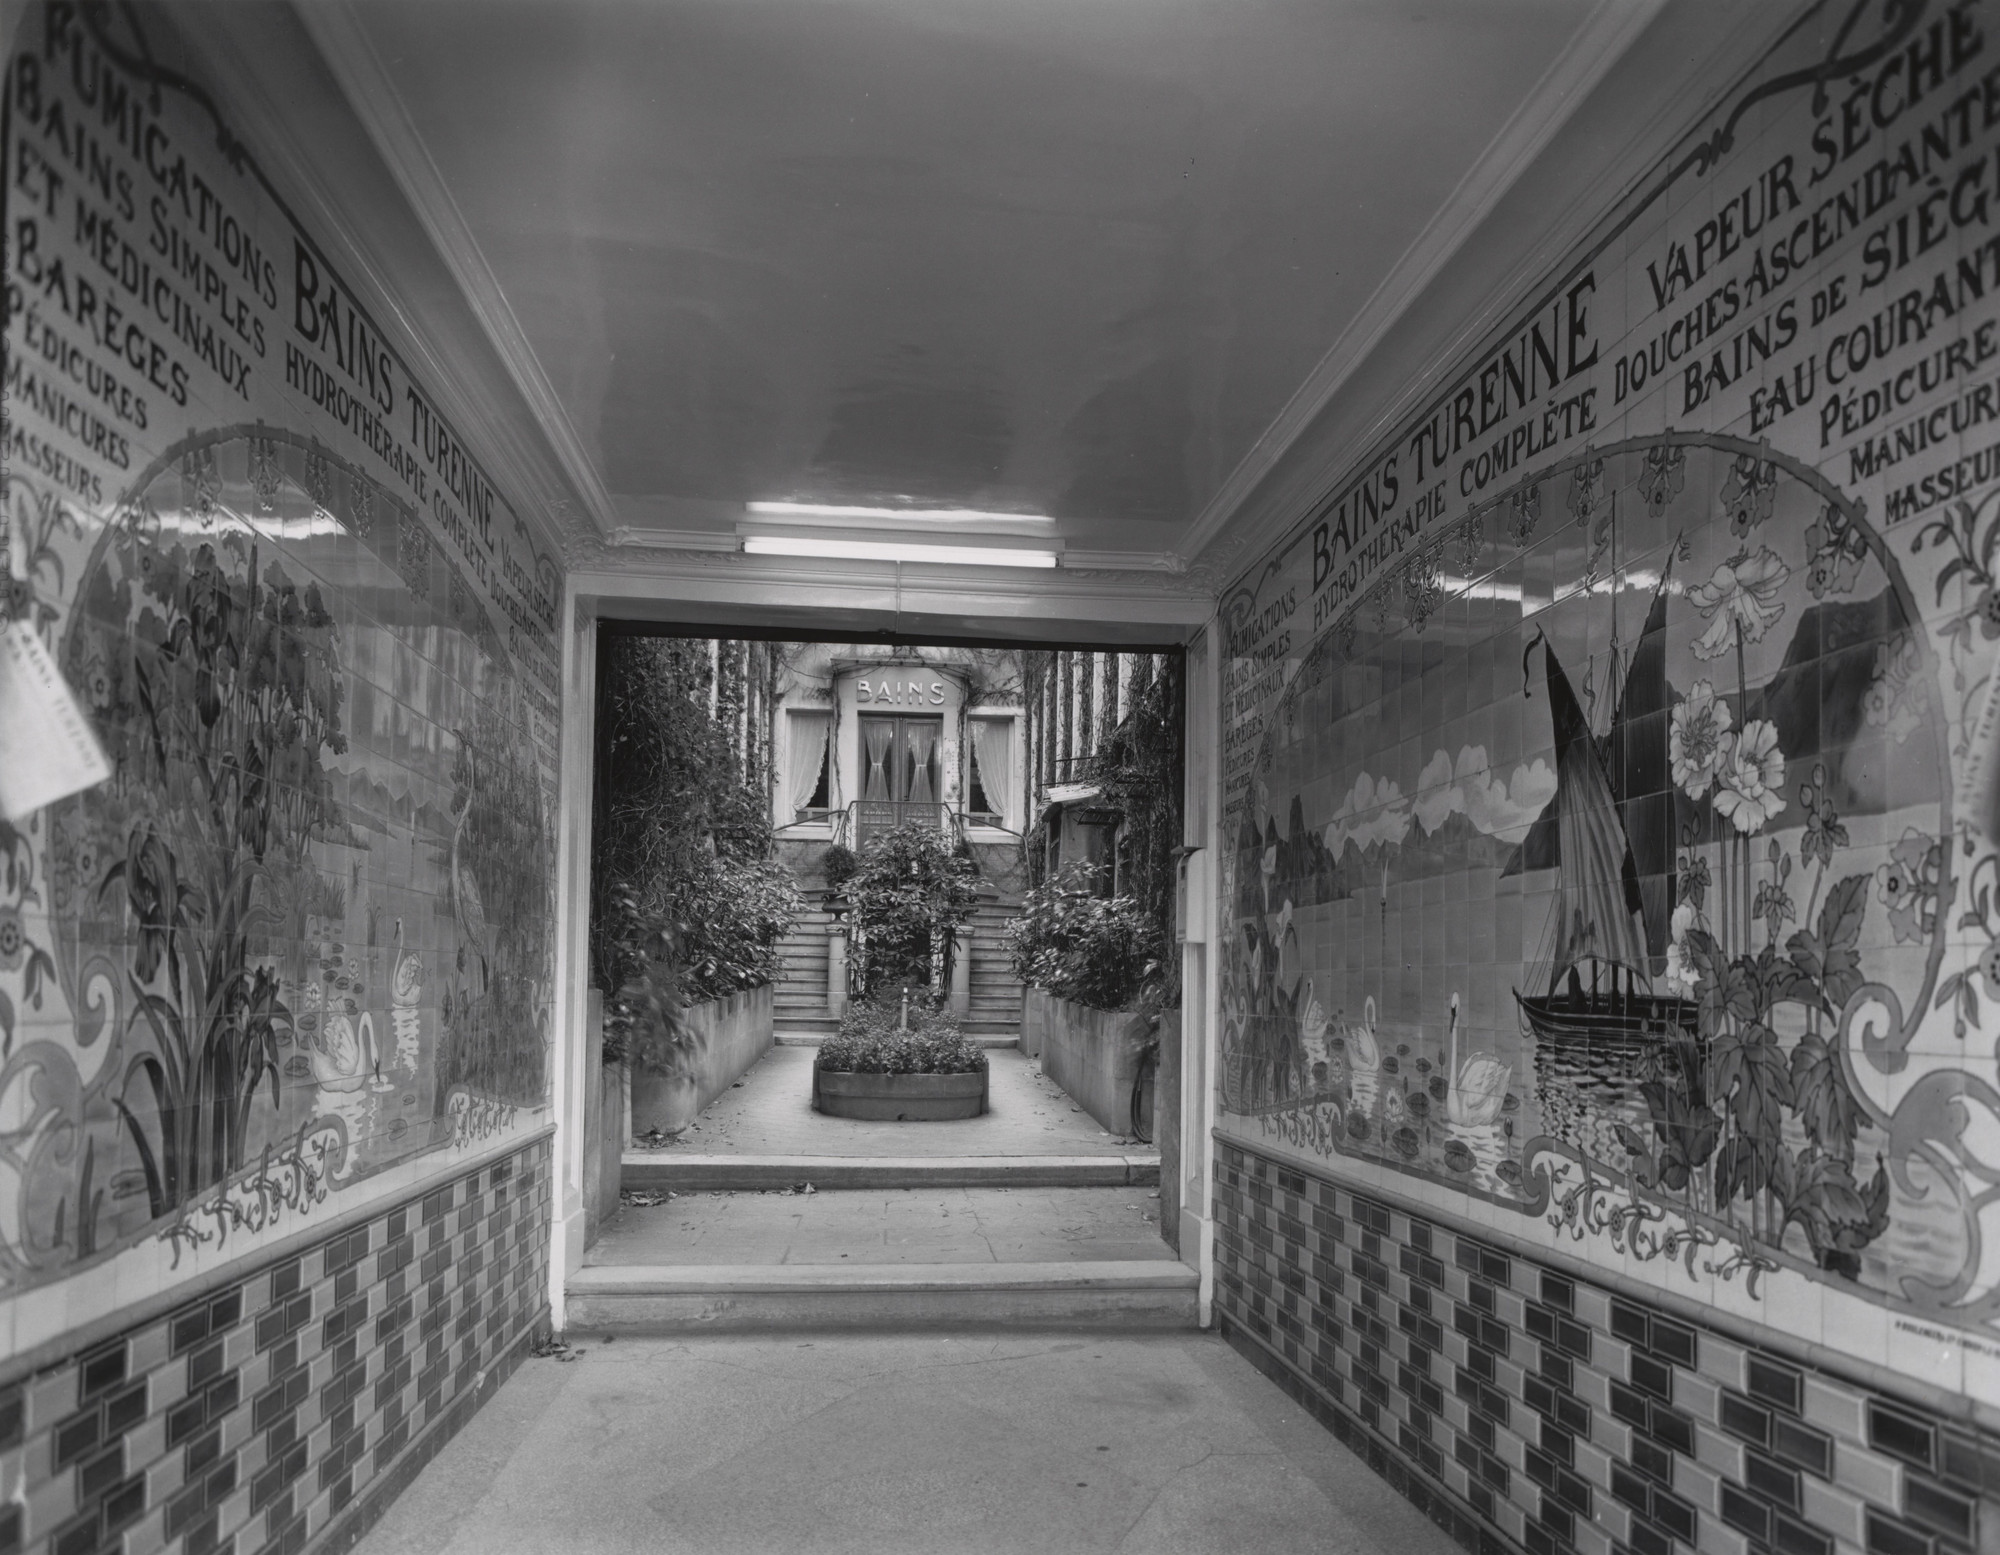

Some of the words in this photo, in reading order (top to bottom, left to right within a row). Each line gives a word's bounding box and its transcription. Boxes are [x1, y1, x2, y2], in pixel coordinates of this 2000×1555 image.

[17, 52, 135, 222] BAINS
[149, 195, 266, 359] SIMPLES
[1645, 154, 1801, 314] VAPEUR
[1807, 0, 1985, 188] SÈCHE
[17, 138, 64, 222] ET
[75, 196, 251, 402] MÉDICINAUX
[17, 217, 190, 408] BARÈGES
[1613, 277, 1740, 407] DOUCHES
[1682, 297, 1798, 418] BAINS
[1810, 274, 1847, 329] DE
[1859, 142, 2000, 297] SIÈG
[285, 340, 428, 506] HYDROTHÉRAPIE
[292, 234, 394, 416] BAINS
[407, 385, 495, 557] TURENNE
[1311, 451, 1400, 596] BAINS
[1409, 270, 1600, 485] TURENNE
[1748, 354, 1817, 436] EAU
[1849, 376, 2000, 486] MANICUR
[500, 536, 533, 610] VAPEUR
[1312, 480, 1447, 634] HYDROTHÉRAPIE
[1459, 385, 1598, 498] COMPLÈTE
[490, 568, 522, 628] DOUCHES
[509, 624, 532, 670] BAINS
[1229, 584, 1297, 663] FUMIGATIONS
[1252, 629, 1291, 678] SIMPLES
[856, 679, 945, 706] BAINS
